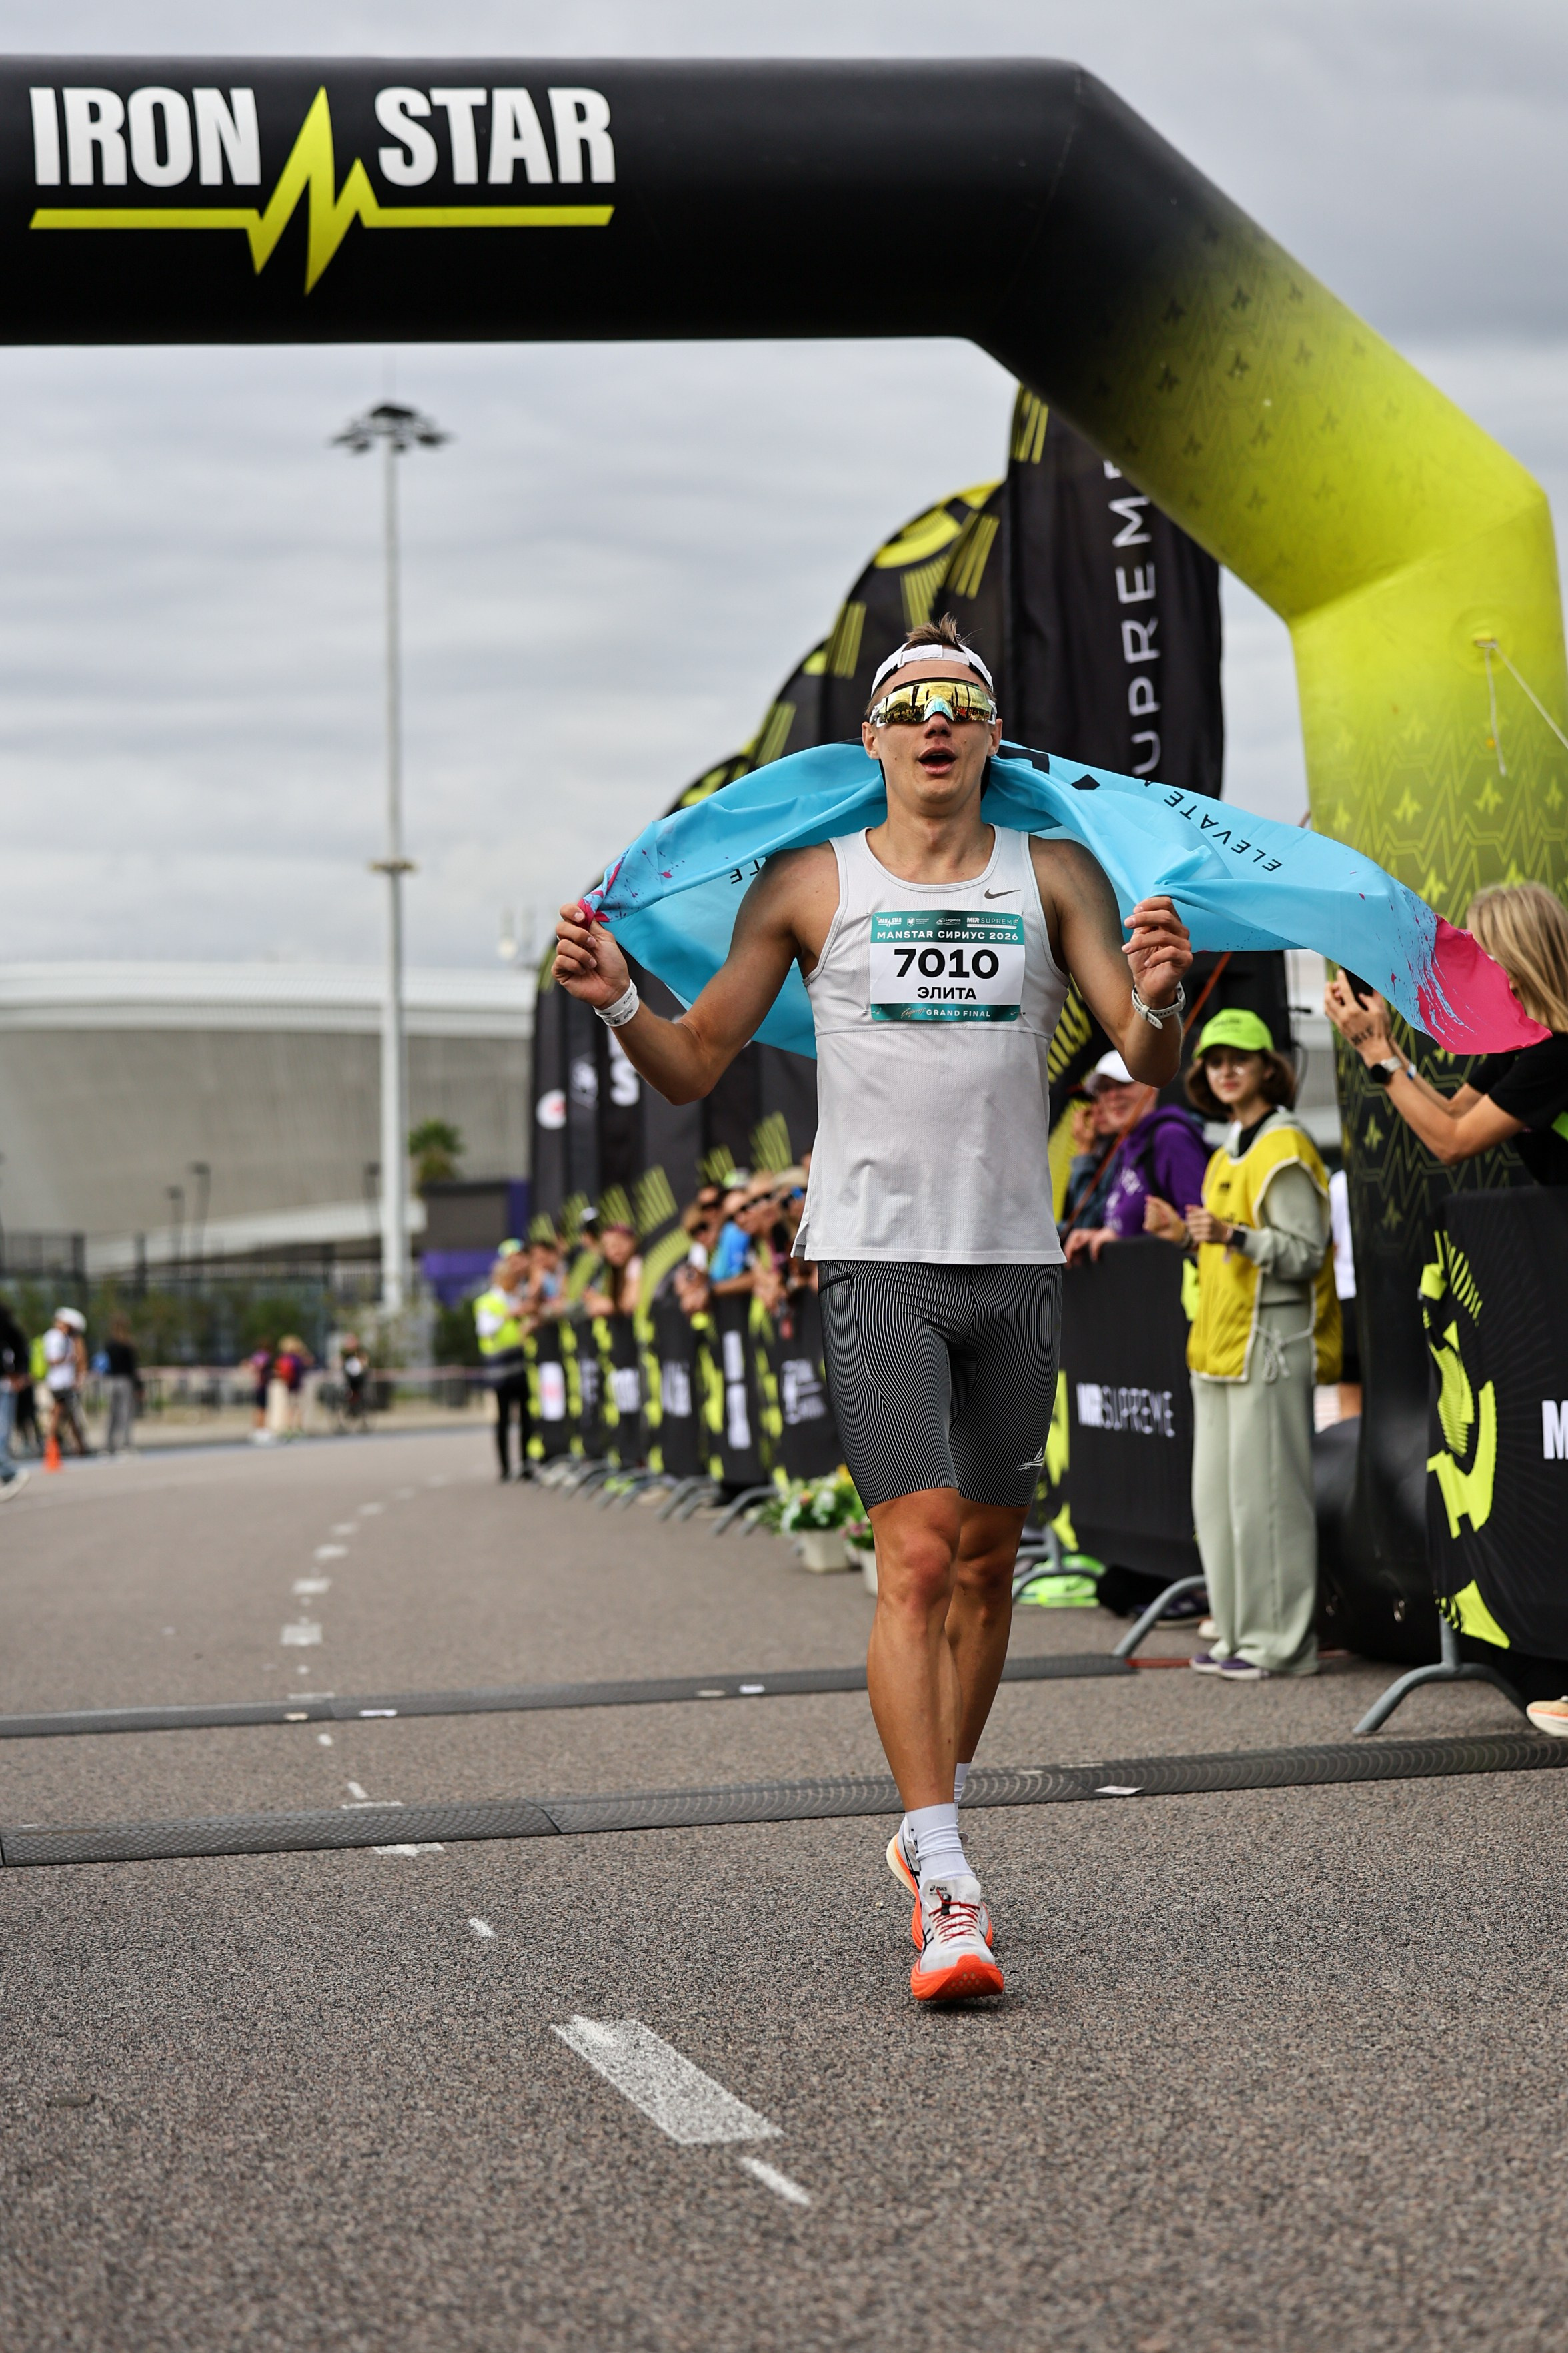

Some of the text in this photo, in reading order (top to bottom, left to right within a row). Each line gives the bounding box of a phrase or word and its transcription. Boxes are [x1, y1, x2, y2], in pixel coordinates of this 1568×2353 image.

[29, 87, 616, 187] IRON STAR
[1102, 458, 1162, 777] UPREM
[1163, 790, 1283, 872] ELEVATE
[877, 931, 1018, 941] MANSTAR СИРИУС 2026
[894, 948, 999, 979] 7010
[917, 986, 977, 1000] ЭЛИТА
